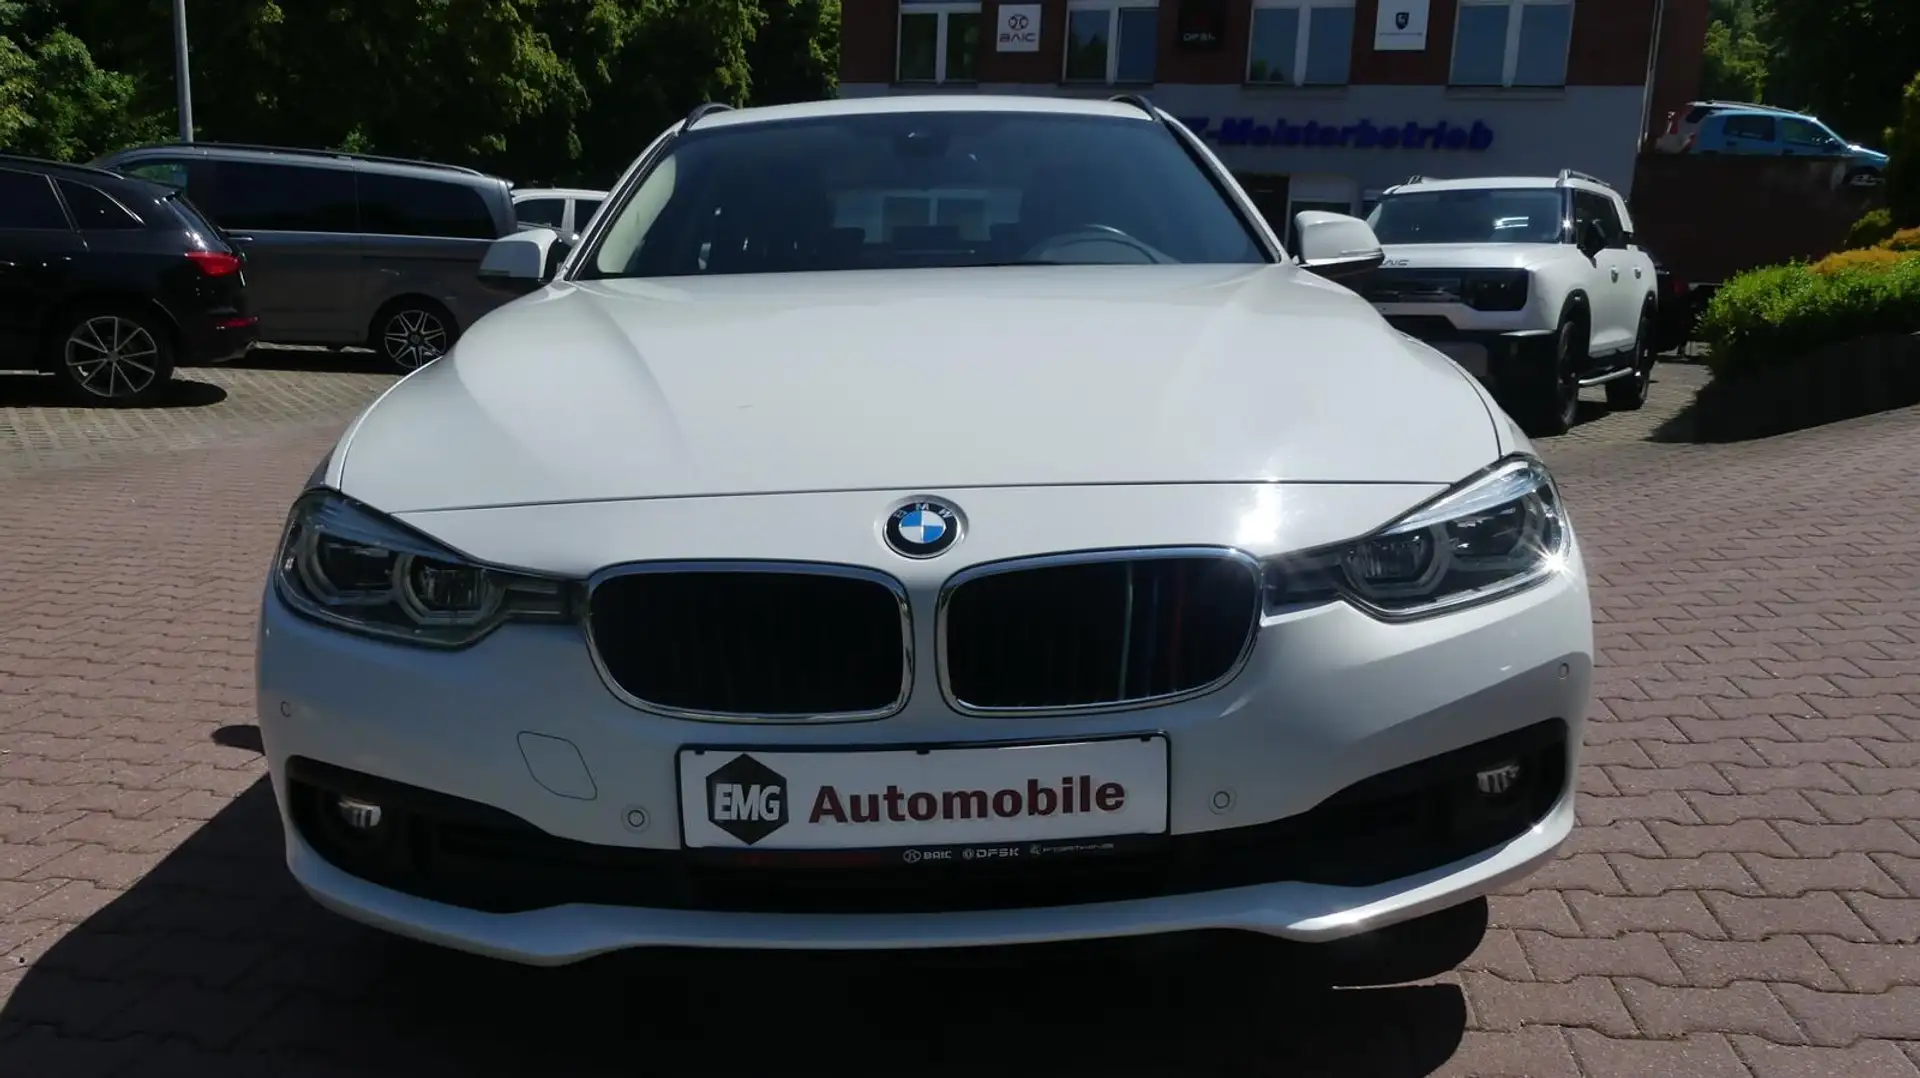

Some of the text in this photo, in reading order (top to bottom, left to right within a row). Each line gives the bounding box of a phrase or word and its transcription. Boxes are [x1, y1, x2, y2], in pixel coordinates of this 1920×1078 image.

[999, 32, 1036, 43] BAIC
[893, 502, 952, 519] BMW
[714, 775, 1125, 823] EMG Automobile
[923, 849, 952, 860] BAIC
[976, 848, 1020, 858] DFSK
